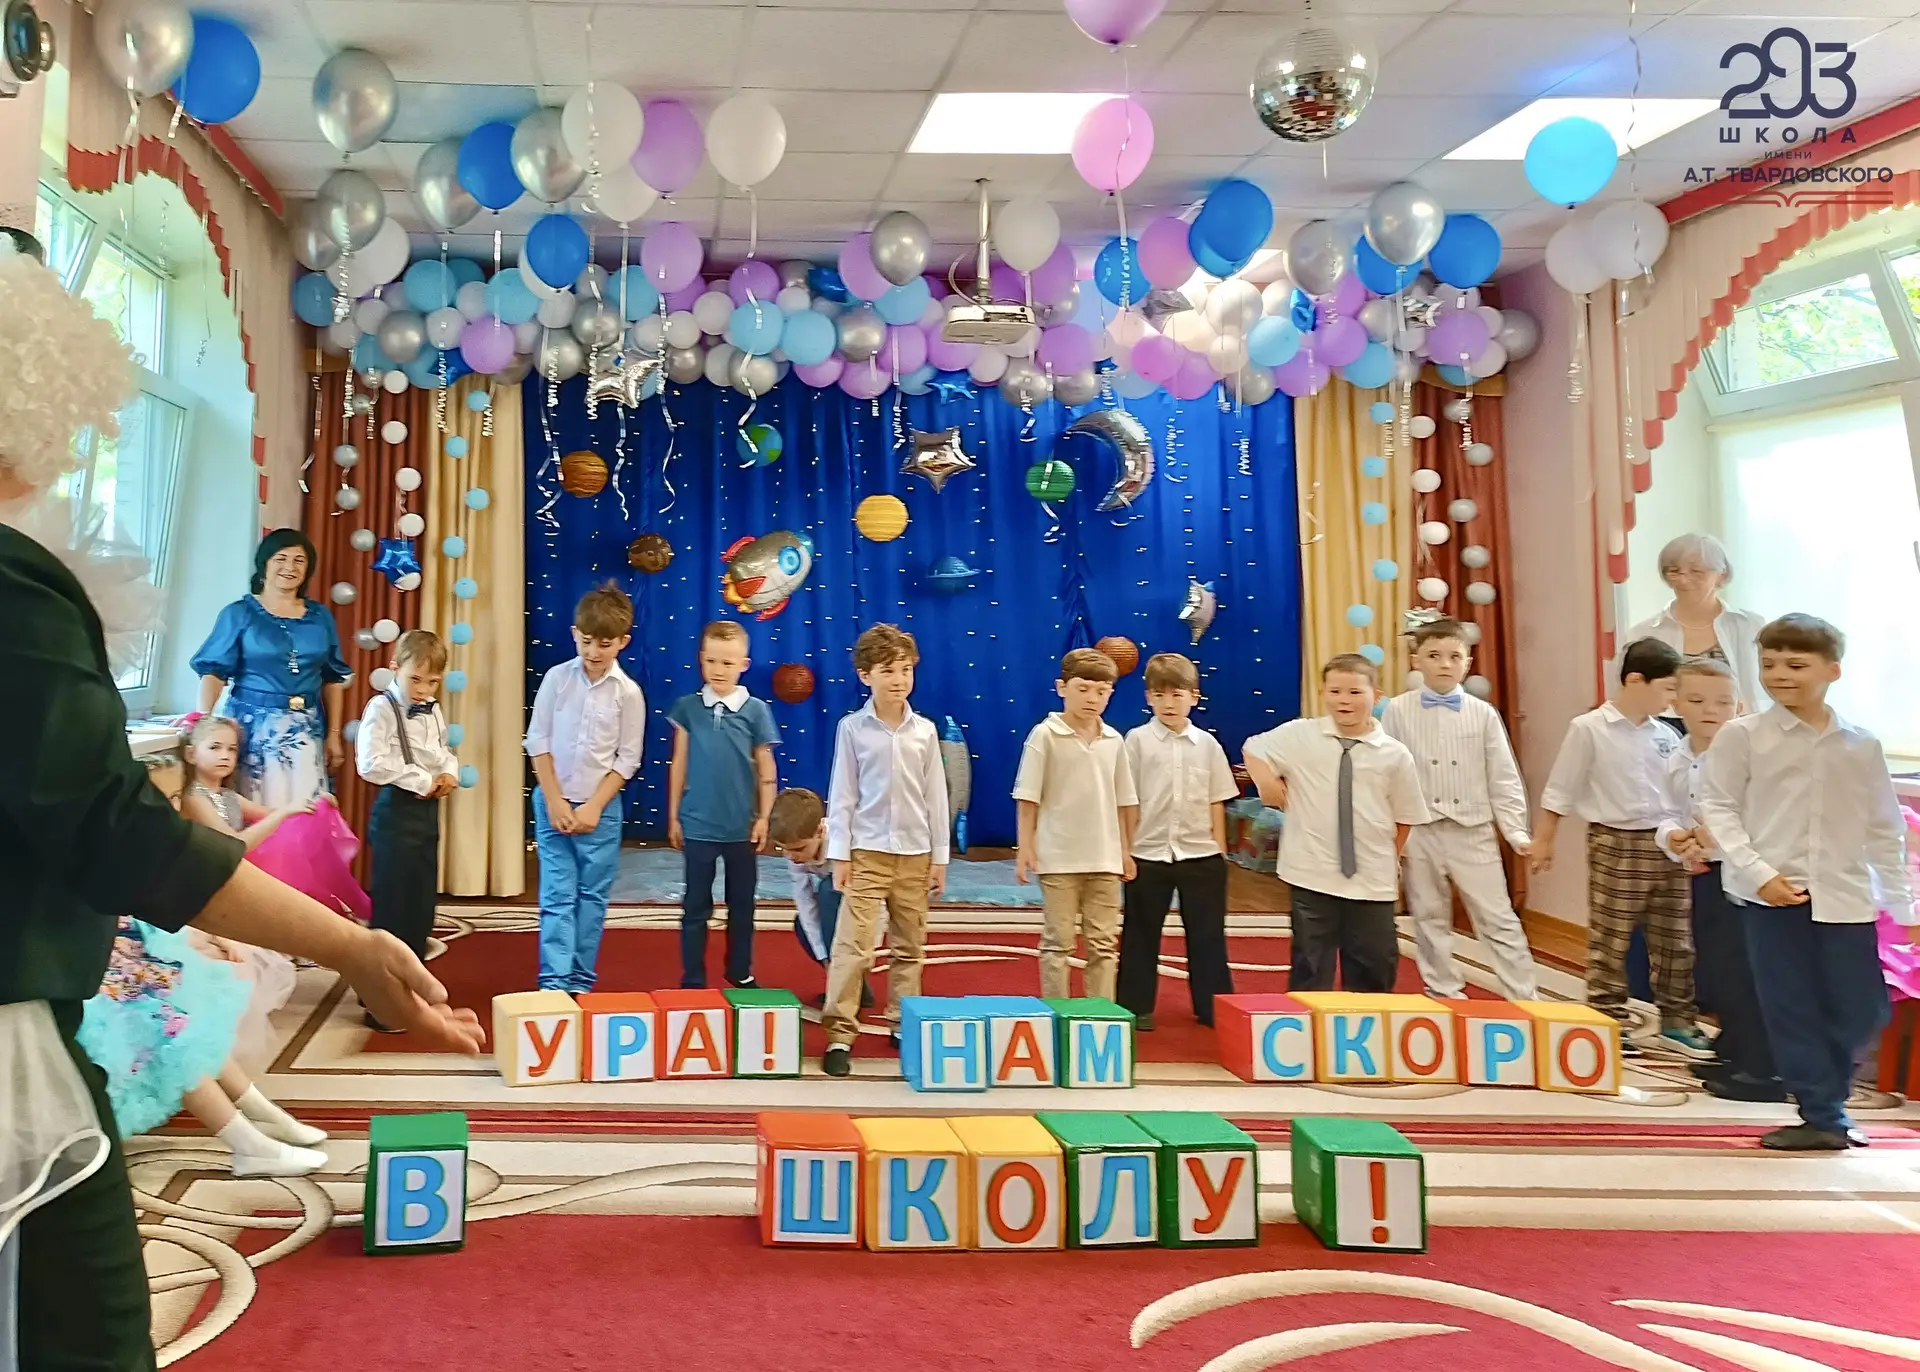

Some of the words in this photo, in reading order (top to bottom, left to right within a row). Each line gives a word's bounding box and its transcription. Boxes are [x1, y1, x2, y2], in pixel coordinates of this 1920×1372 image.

[524, 1012, 776, 1078] УРА!
[930, 1020, 1123, 1084] НАМ
[1262, 1015, 1606, 1087] СКОРО
[386, 1155, 449, 1241] В
[779, 1156, 1245, 1245] ШКОЛУ
